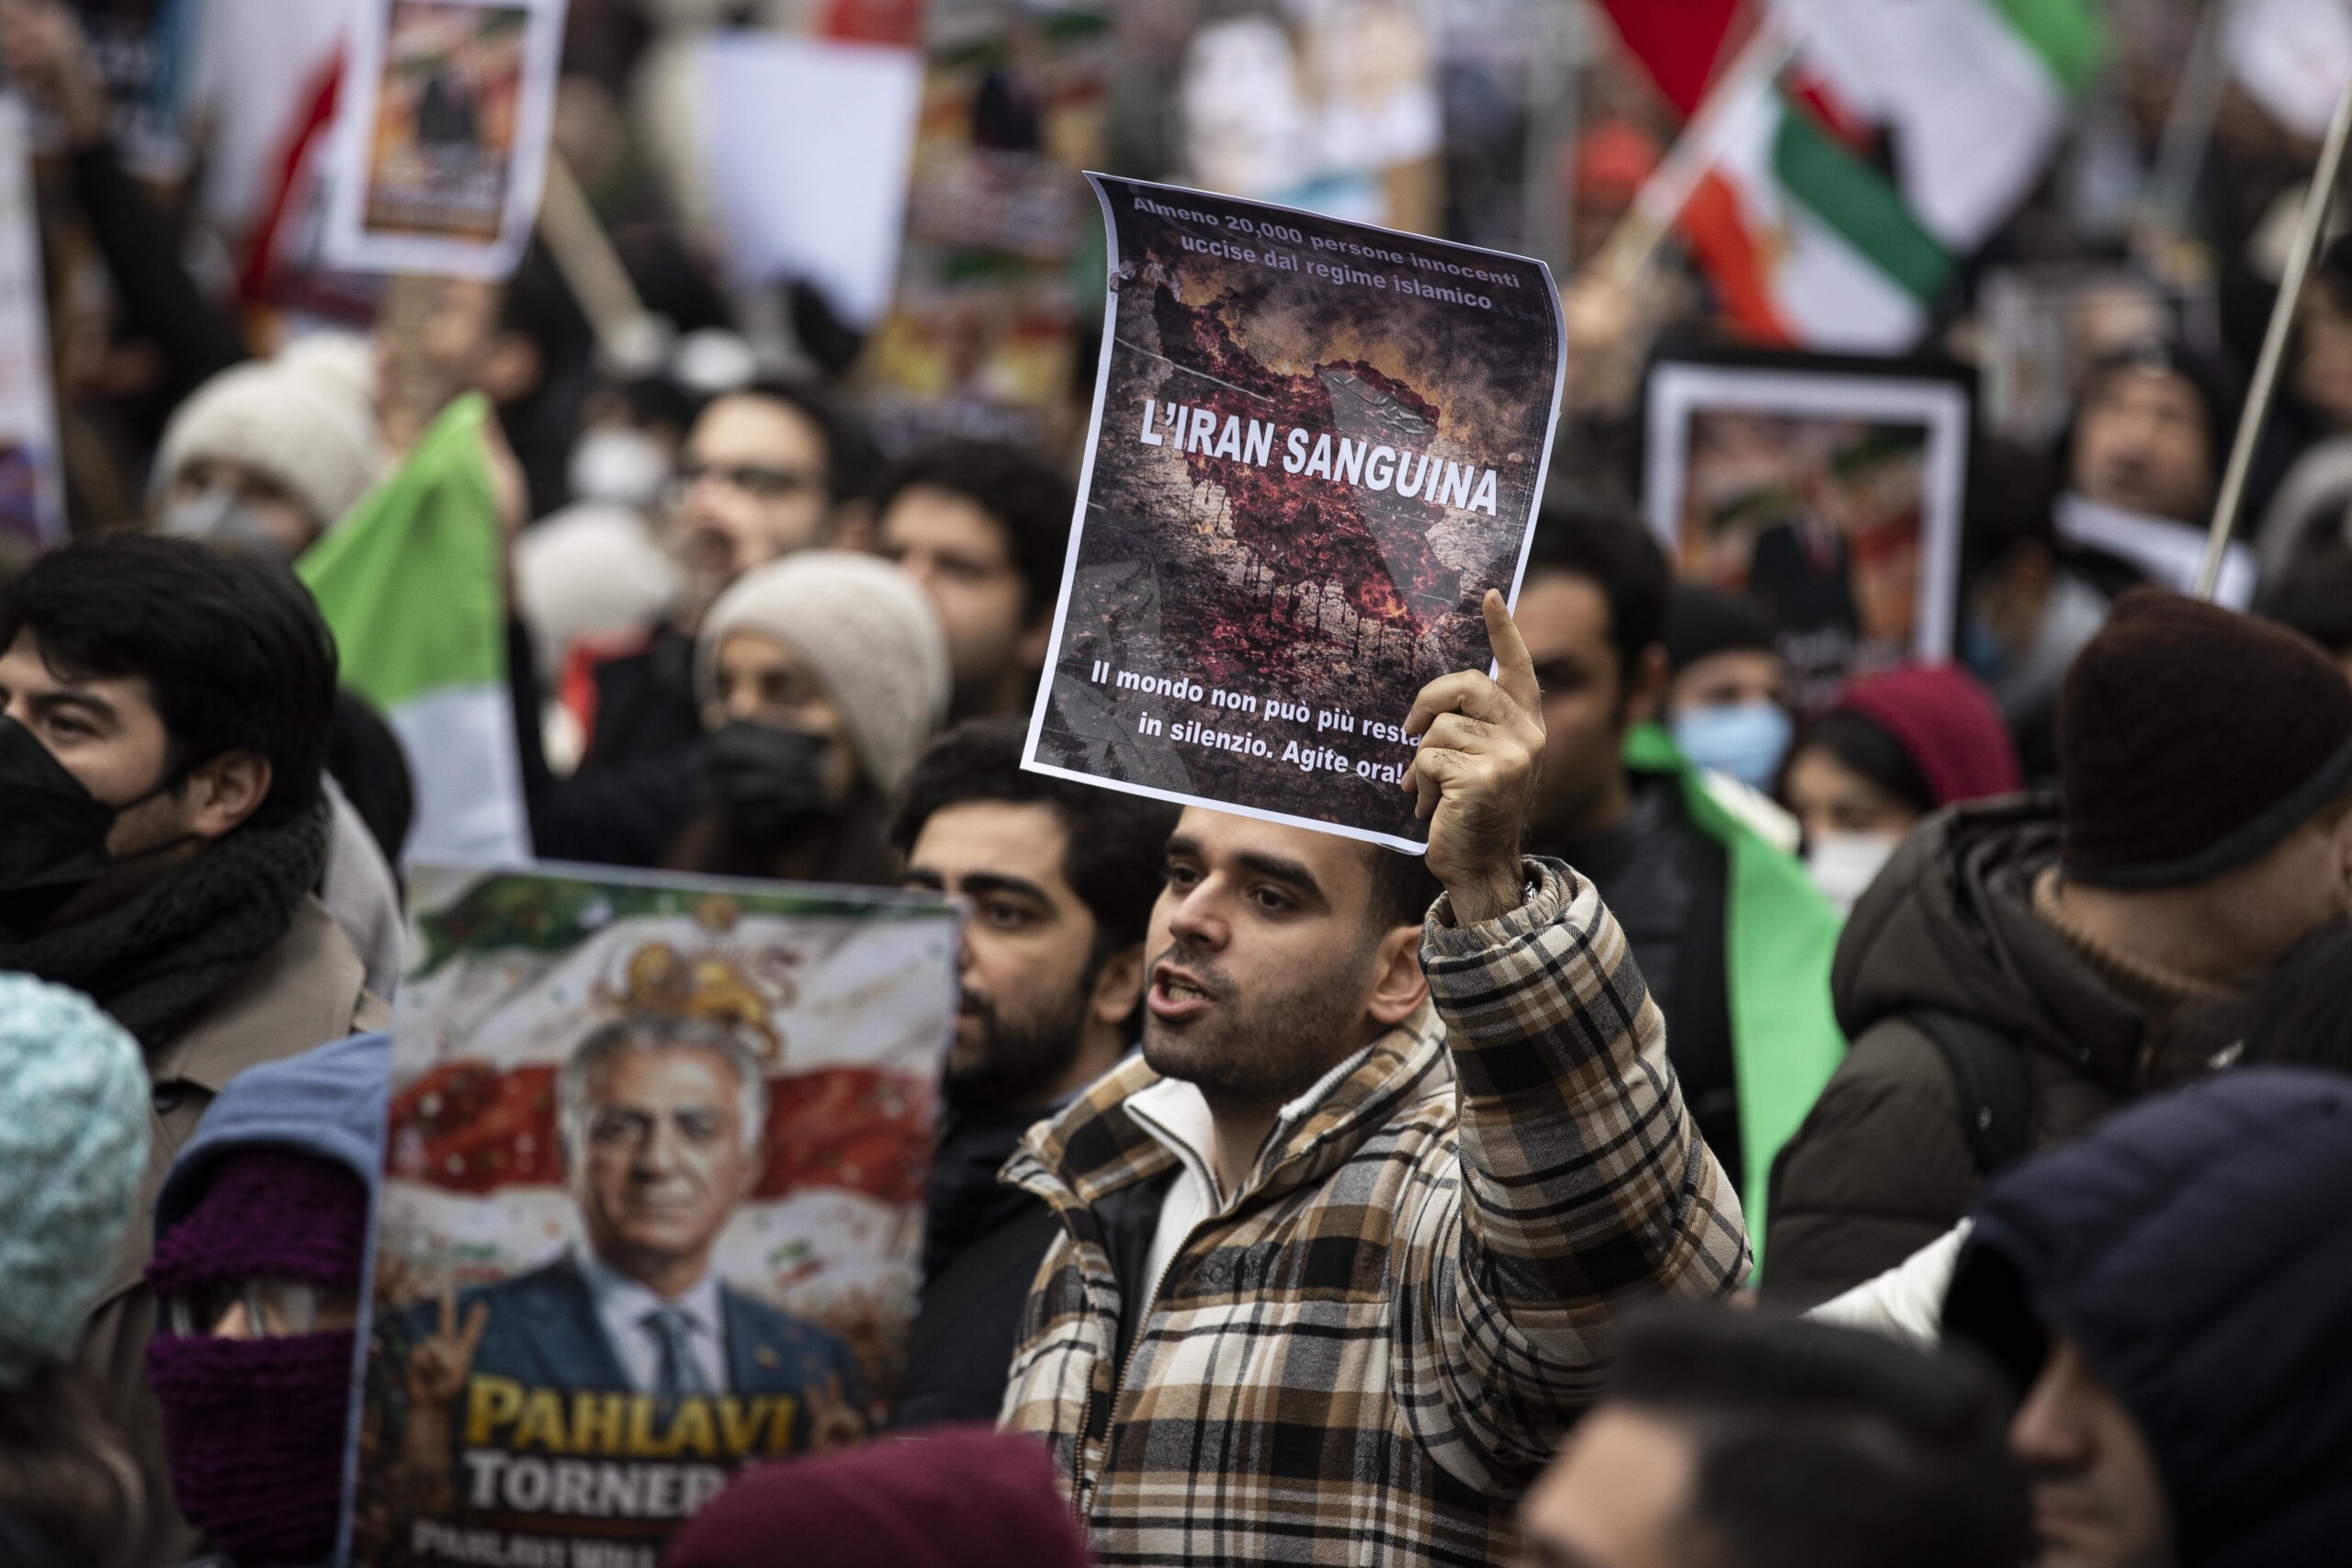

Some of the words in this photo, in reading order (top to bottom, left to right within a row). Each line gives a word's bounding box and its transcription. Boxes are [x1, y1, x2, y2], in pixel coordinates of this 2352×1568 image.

[1134, 197, 1220, 226] Almeno
[1225, 215, 1303, 243] 20,000
[1310, 234, 1404, 265] persone
[1410, 253, 1521, 288] innocenti
[1182, 235, 1256, 264] uccise
[1264, 250, 1298, 272] dal
[1306, 261, 1386, 289] regime
[1394, 275, 1492, 310] islamico
[1139, 399, 1275, 468] L’IRAN
[1283, 427, 1498, 516] SANGUINA
[1091, 660, 1110, 684] Il
[1116, 671, 1204, 702] mondo
[1211, 689, 1257, 713] non
[1263, 700, 1310, 723] può
[1317, 707, 1355, 732] più
[1137, 711, 1162, 737] in
[1170, 720, 1273, 759] silenzio.
[1281, 739, 1349, 773] Agite
[1356, 760, 1404, 785] ora!
[464, 1377, 798, 1458] PAHLAVI
[462, 1449, 730, 1518] TORNER
